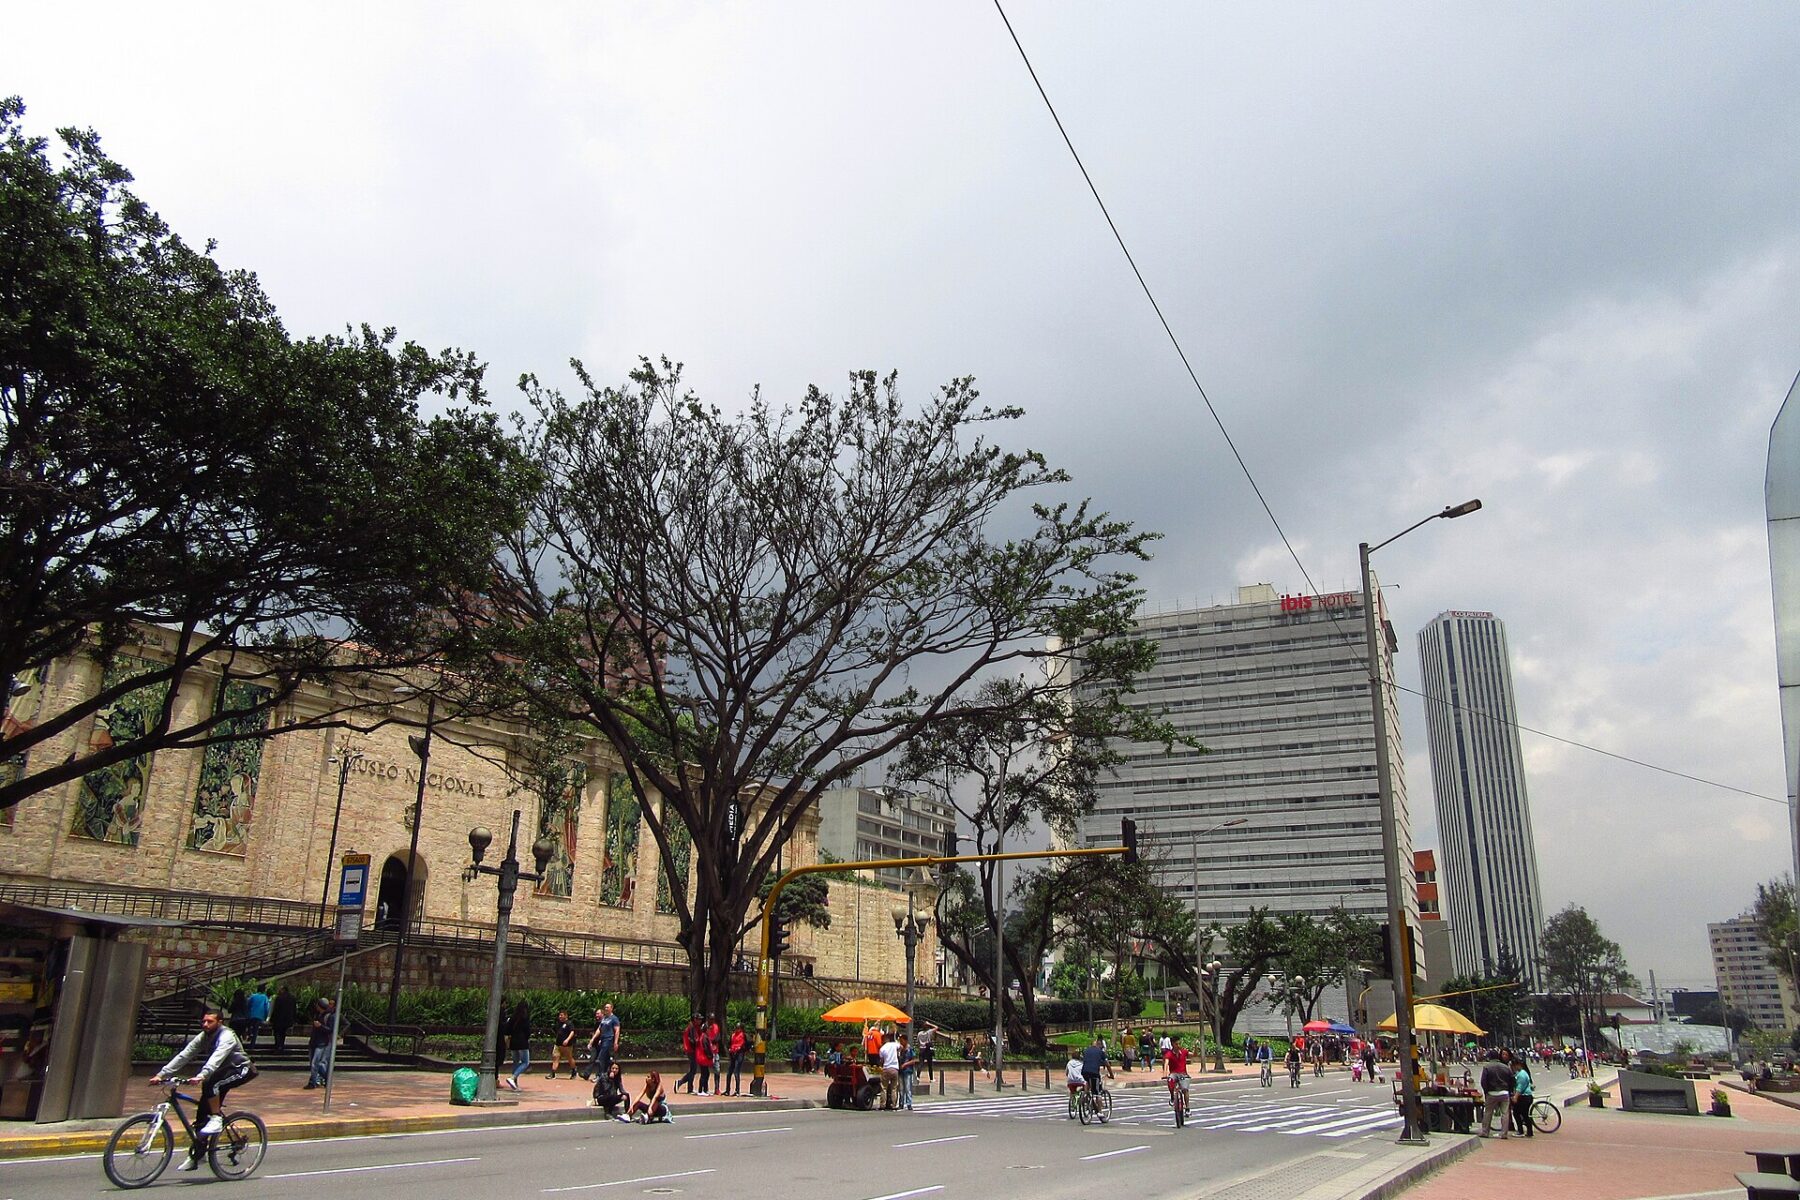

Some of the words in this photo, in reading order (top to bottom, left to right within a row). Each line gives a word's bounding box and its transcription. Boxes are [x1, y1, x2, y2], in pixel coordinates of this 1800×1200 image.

[1280, 593, 1312, 611] ibis
[1319, 592, 1357, 608] HOTEL
[404, 768, 486, 798] NCIONAL
